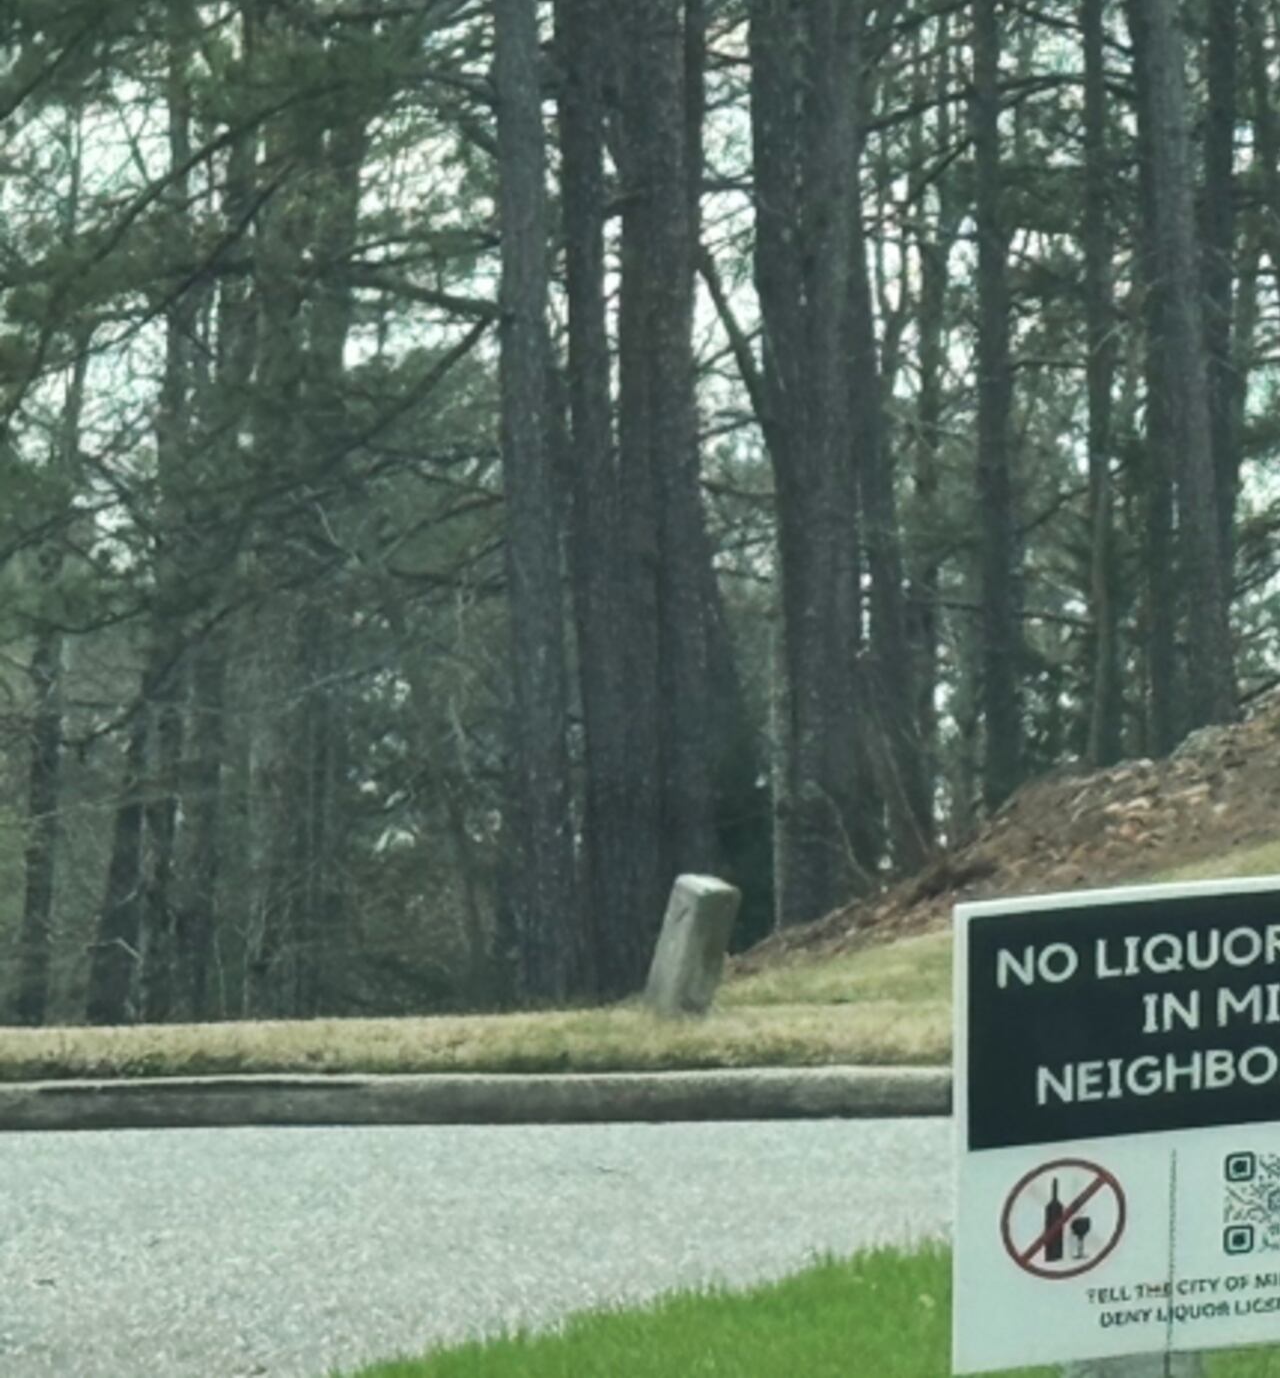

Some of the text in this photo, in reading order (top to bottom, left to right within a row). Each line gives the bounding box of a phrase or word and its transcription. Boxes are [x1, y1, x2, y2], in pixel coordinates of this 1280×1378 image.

[996, 941, 1079, 990] NO
[1142, 989, 1199, 1034] IN
[1087, 1283, 1132, 1304] TELL
[1135, 1281, 1172, 1300] THE
[1176, 1277, 1219, 1296] CITY
[1225, 1275, 1249, 1292] OF
[1100, 1307, 1152, 1328] DENY
[1156, 1300, 1230, 1323] LIQUOR
